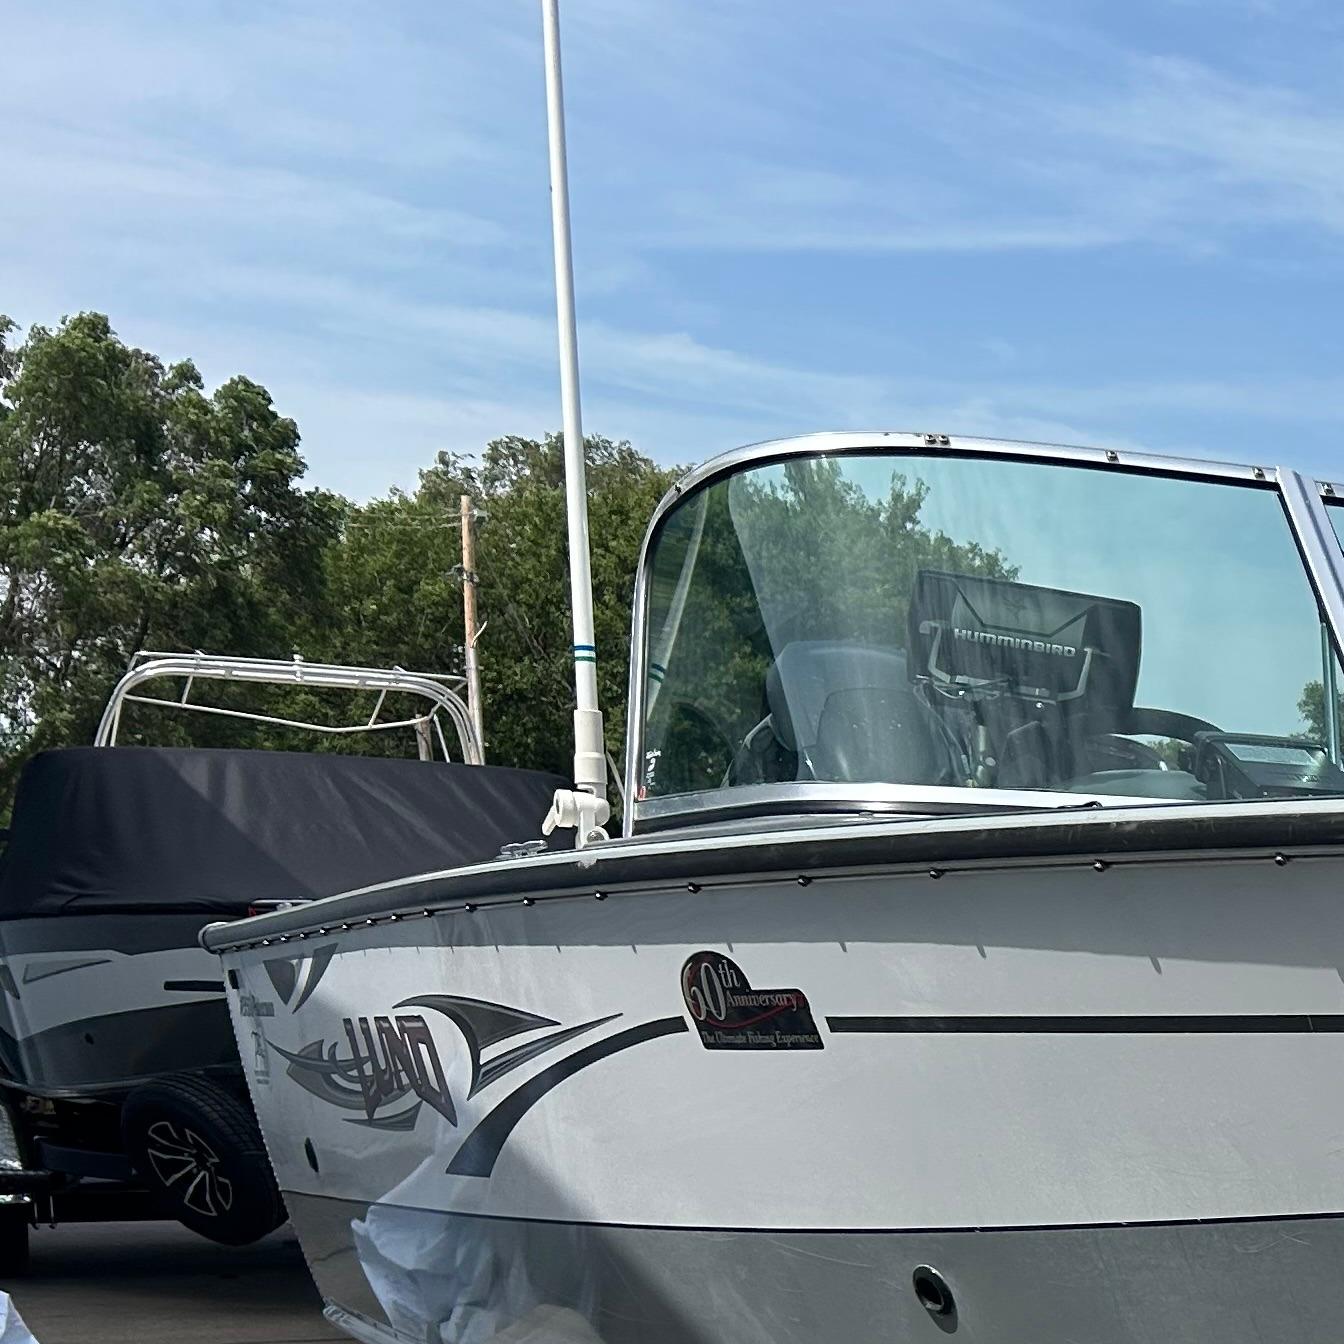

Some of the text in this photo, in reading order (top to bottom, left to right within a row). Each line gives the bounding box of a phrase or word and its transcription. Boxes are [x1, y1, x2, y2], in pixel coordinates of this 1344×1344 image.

[953, 627, 1077, 658] HUMMINBIRD
[726, 991, 798, 1012] Anniversary
[776, 1030, 819, 1048] Experience
[343, 1015, 458, 1128] LUND
